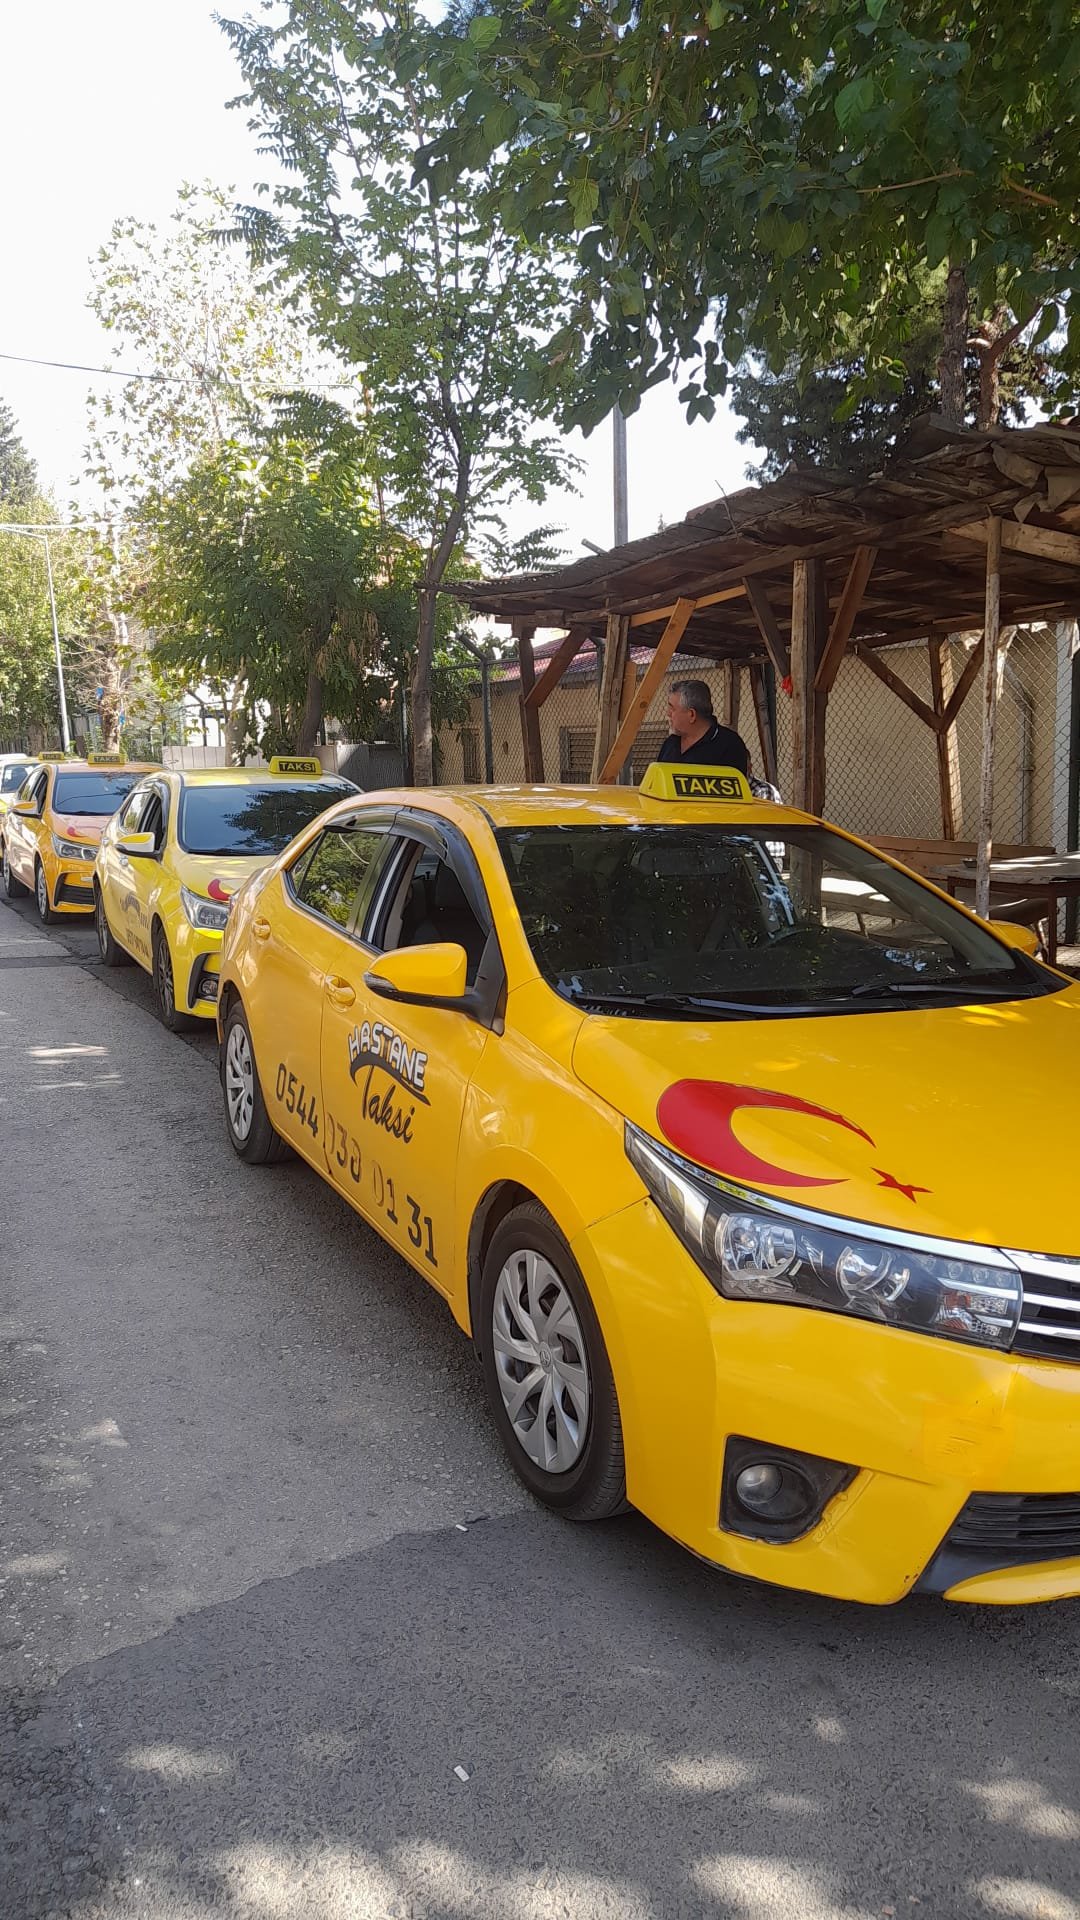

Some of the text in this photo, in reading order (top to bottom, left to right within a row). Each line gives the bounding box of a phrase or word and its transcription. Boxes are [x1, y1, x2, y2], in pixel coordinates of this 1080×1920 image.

[348, 1020, 428, 1092] HASTANE
[356, 1060, 418, 1144] Taksi
[275, 1063, 318, 1138] 0544
[406, 1194, 439, 1268] 31
